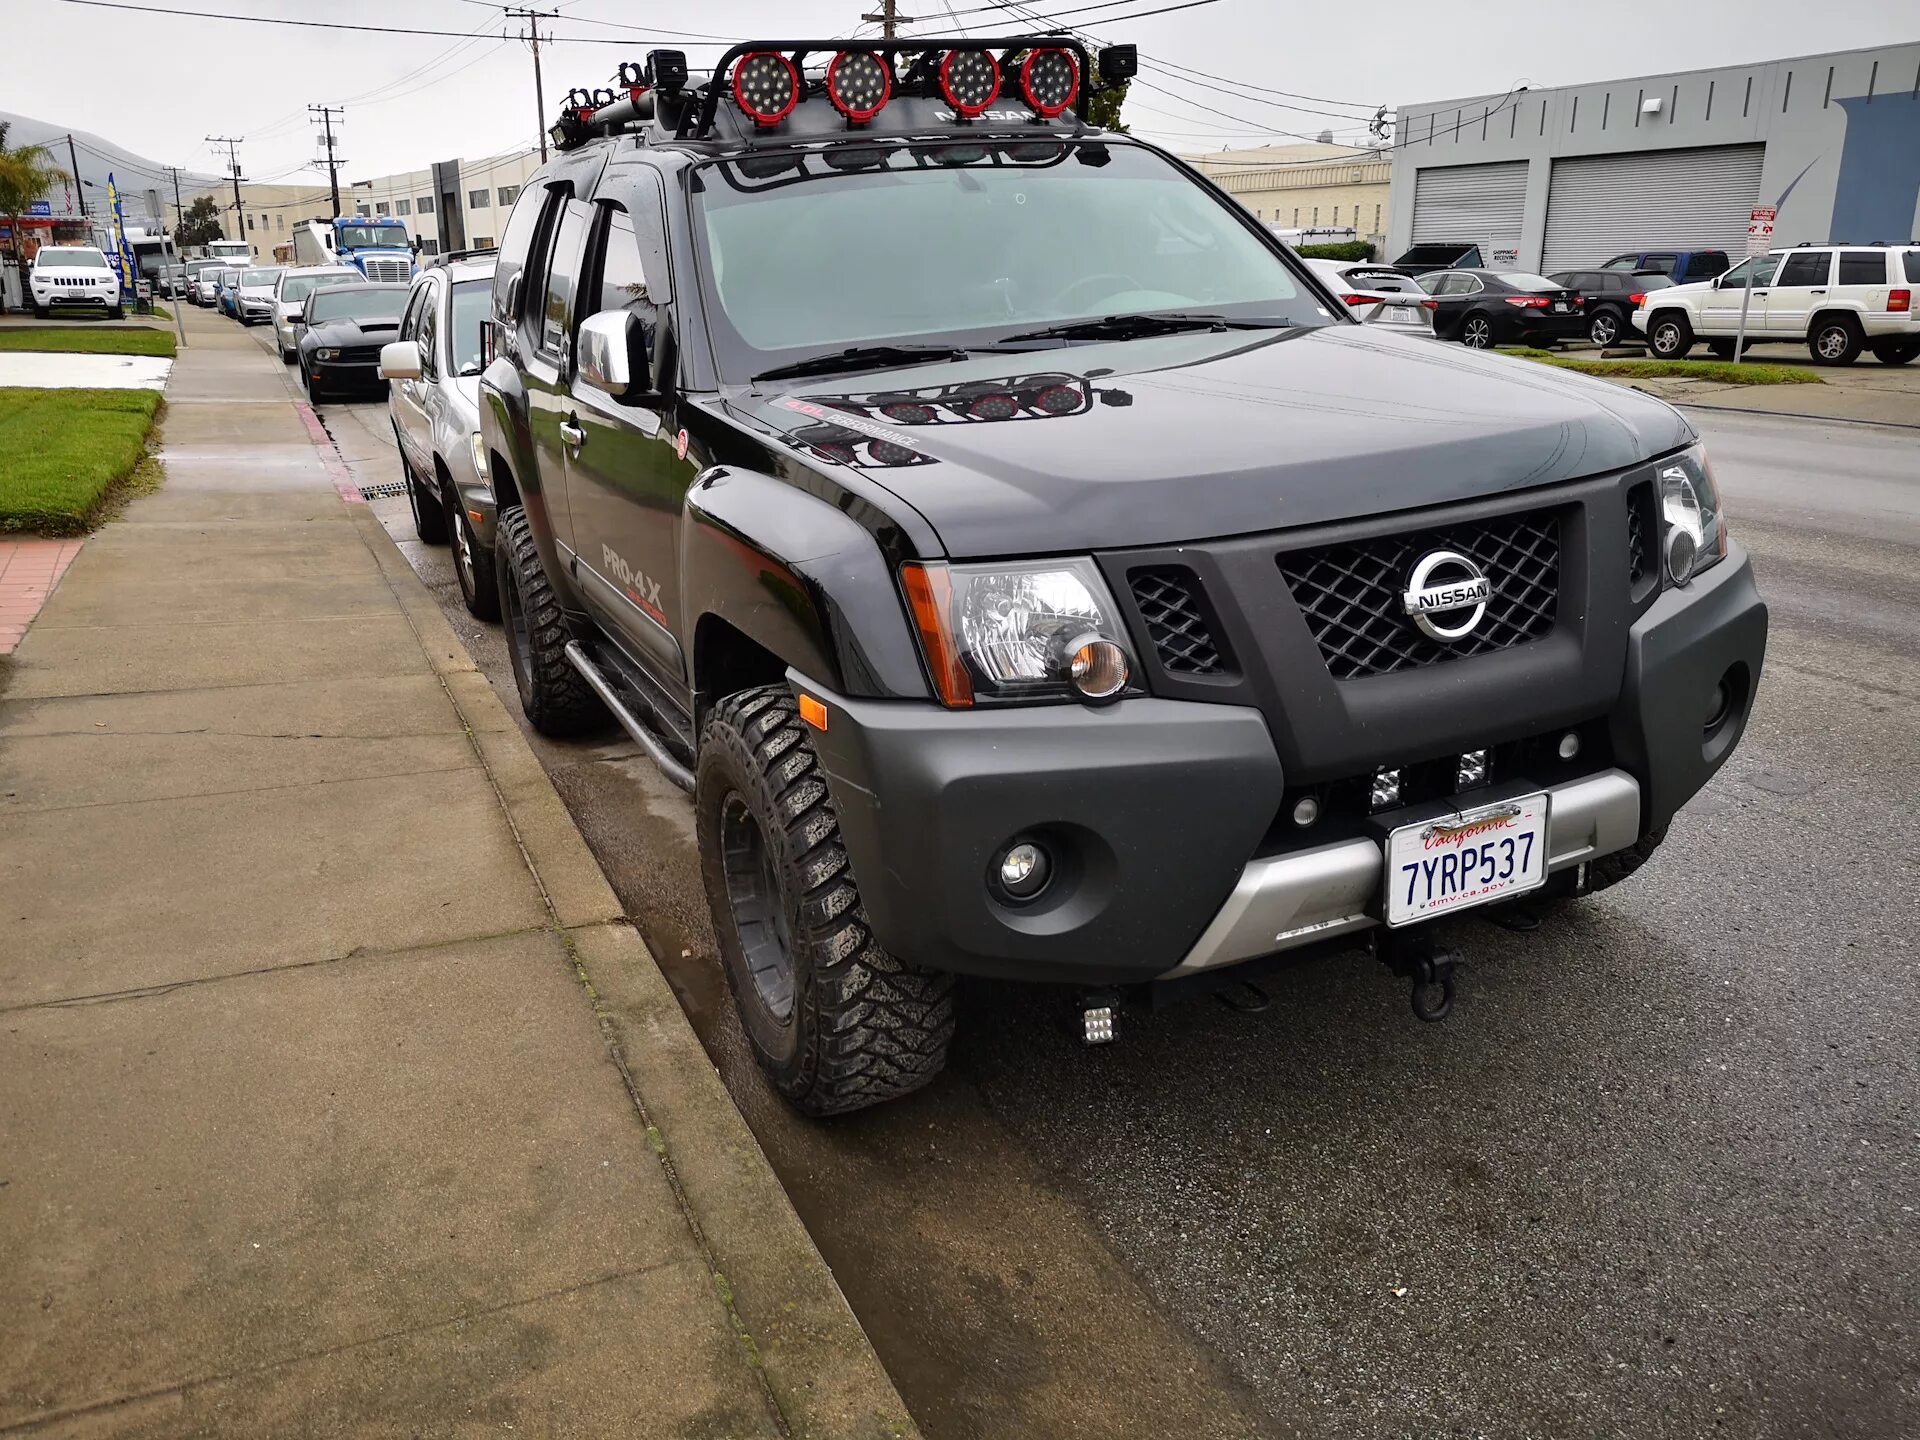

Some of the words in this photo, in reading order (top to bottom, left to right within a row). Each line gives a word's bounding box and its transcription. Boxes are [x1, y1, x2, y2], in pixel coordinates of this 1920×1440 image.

[827, 413, 920, 446] PERFORMANCE
[1418, 581, 1488, 609] NISSAN
[1402, 831, 1534, 905] 7YRP537
[1428, 881, 1506, 908] dmv.ca.gov
